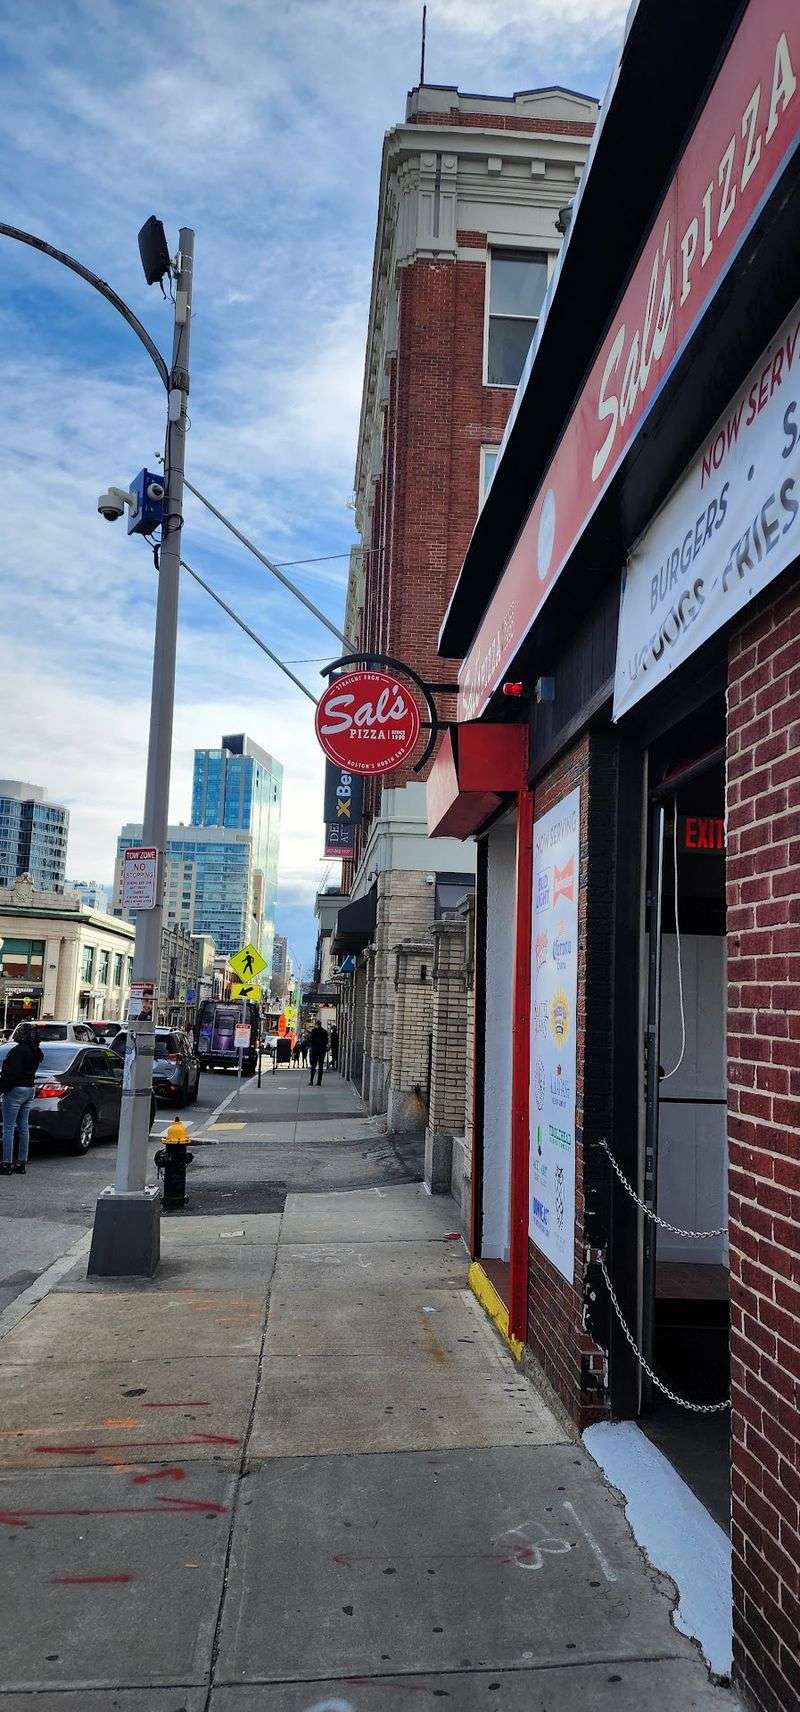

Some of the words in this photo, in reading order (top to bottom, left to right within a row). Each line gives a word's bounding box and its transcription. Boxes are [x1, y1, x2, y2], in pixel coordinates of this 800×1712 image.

[592, 218, 674, 481] Sal's
[680, 31, 796, 308] PIZZA
[700, 399, 745, 489] NOW
[746, 318, 800, 426] SERV
[650, 482, 730, 615] BURGERS
[783, 400, 800, 459] S
[722, 477, 799, 592] FRIES
[320, 684, 408, 735] Sal's
[349, 729, 386, 740] PIZZA
[139, 851, 155, 859] ZONE
[686, 817, 723, 849] EXIT
[133, 863, 146, 871] NO
